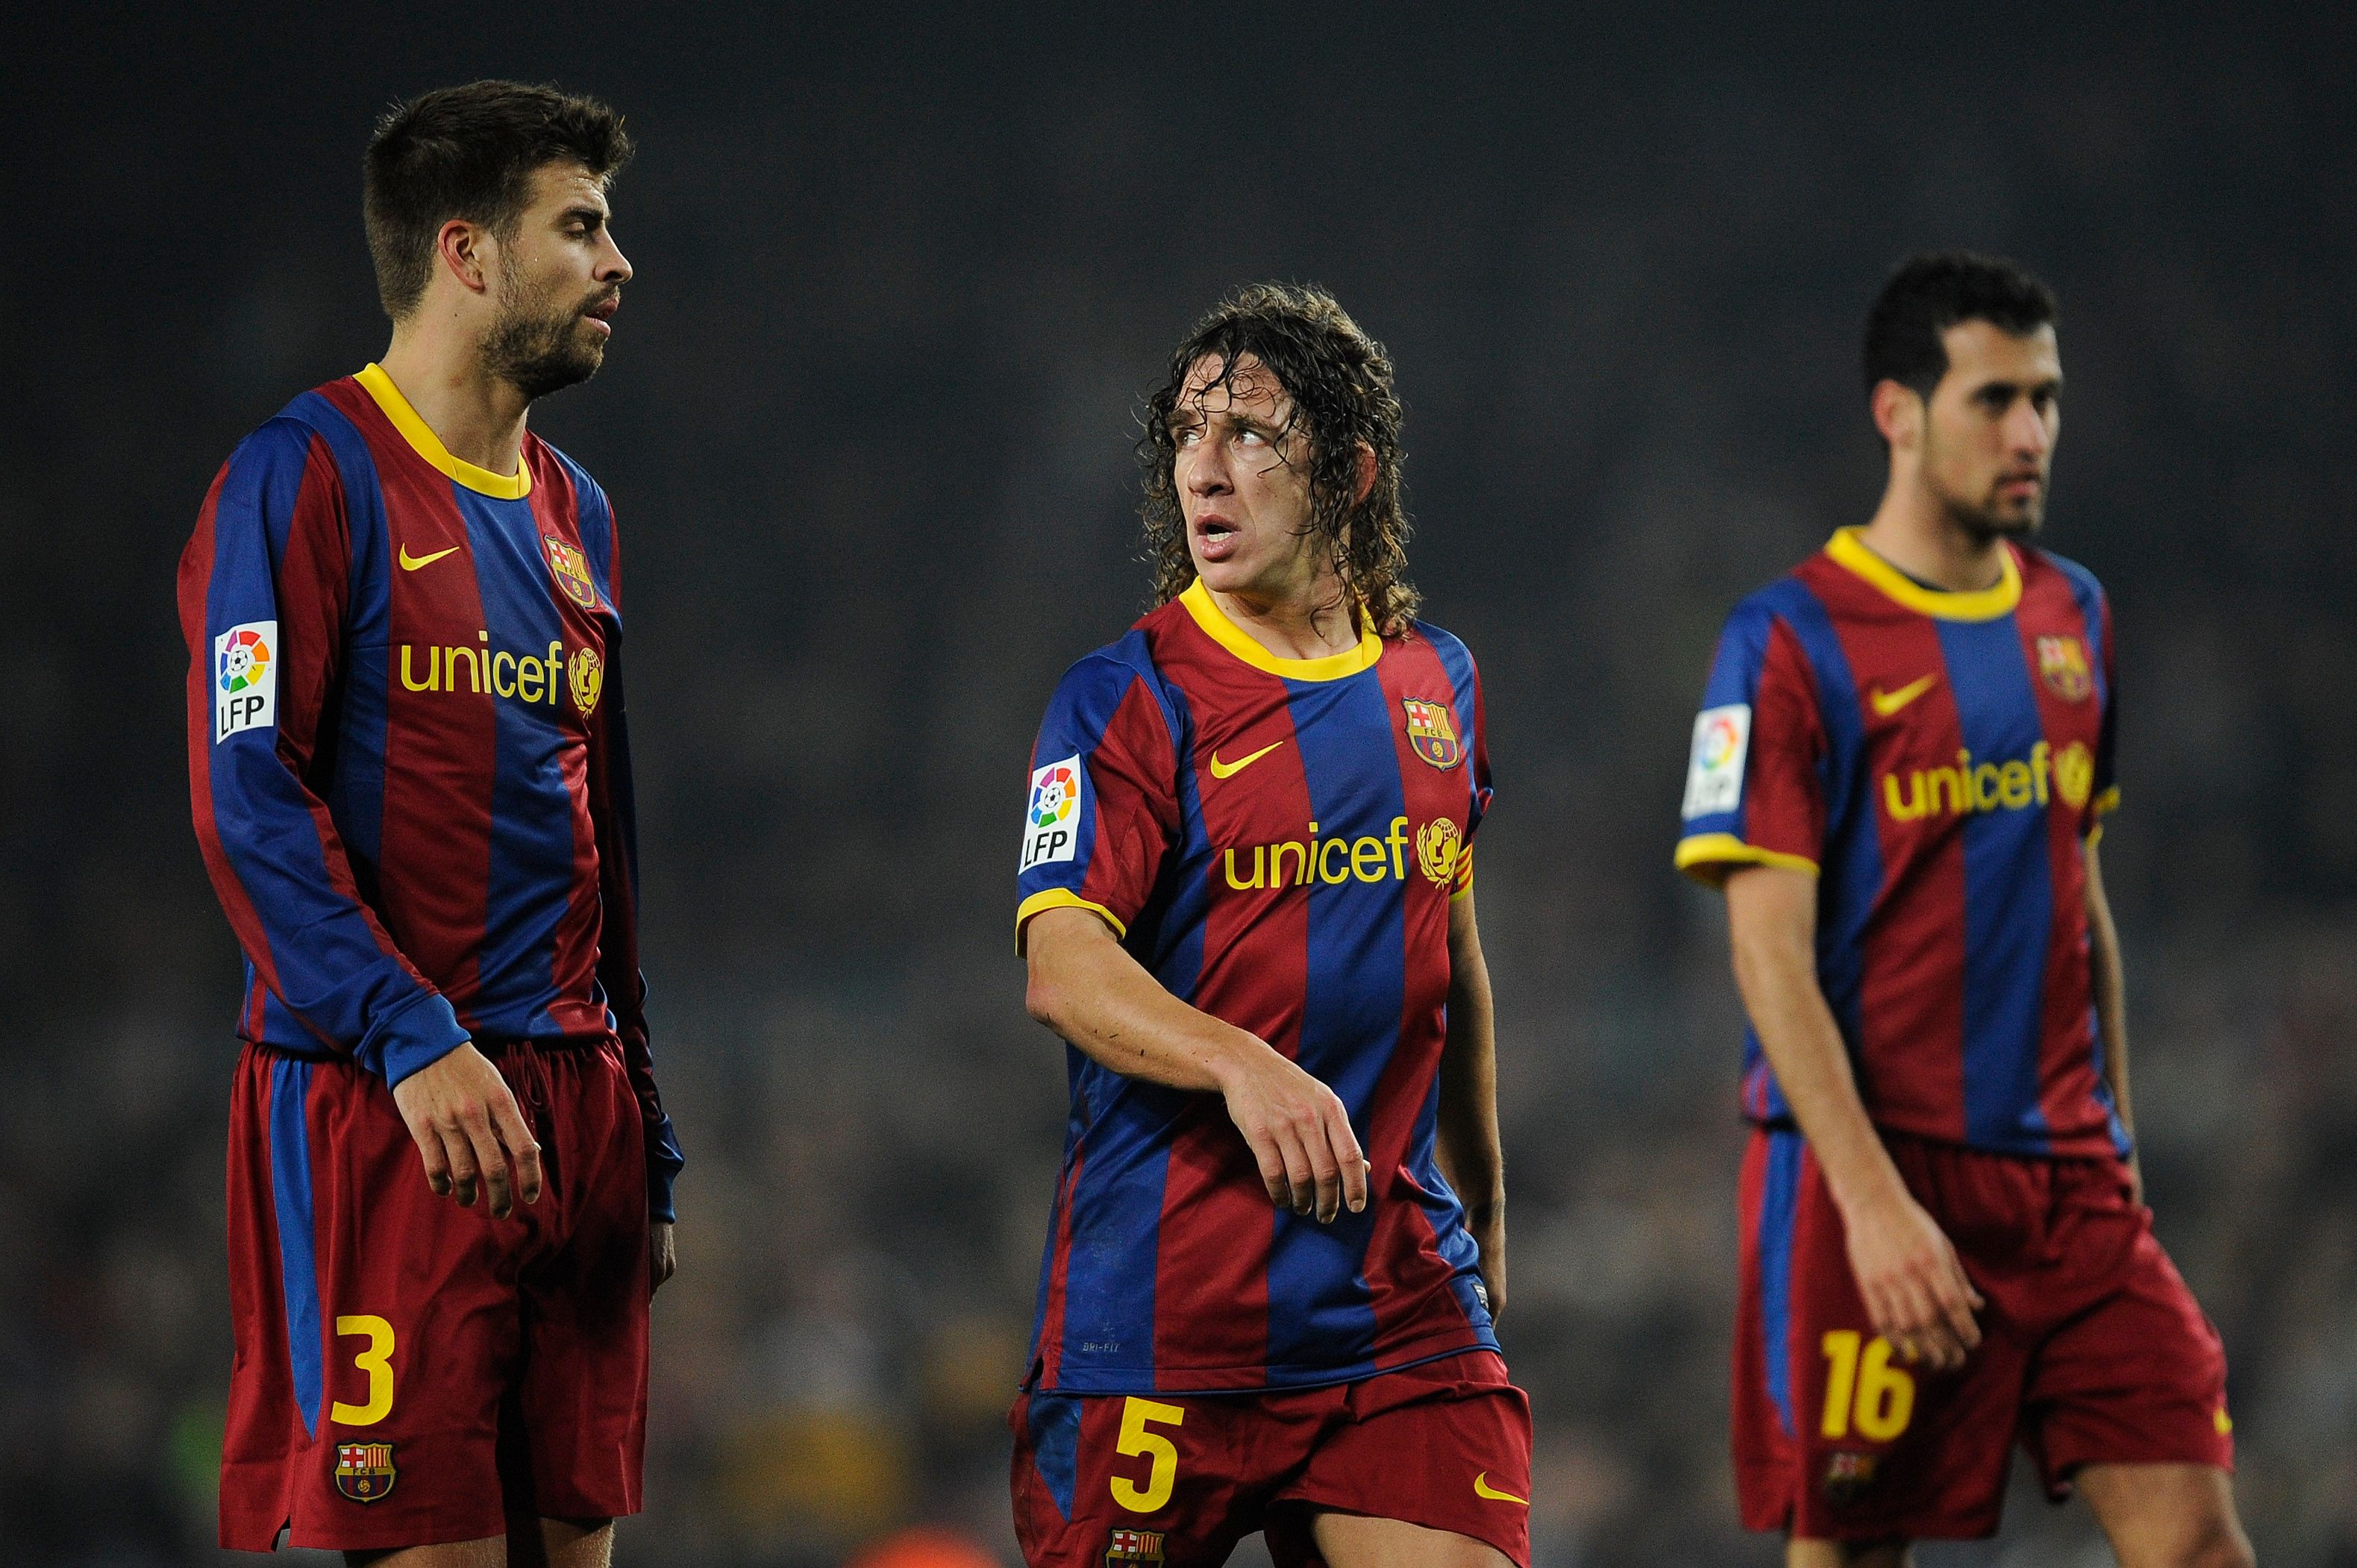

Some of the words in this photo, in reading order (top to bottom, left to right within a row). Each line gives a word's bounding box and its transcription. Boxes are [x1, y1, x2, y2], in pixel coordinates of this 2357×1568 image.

[401, 630, 563, 705] unicef
[221, 695, 265, 736] LFP
[1424, 728, 1443, 737] FCB
[1884, 740, 2050, 821] unicef
[1024, 830, 1068, 868] LFP
[1224, 816, 1409, 890] unicef
[331, 1314, 395, 1426] 3
[1083, 1342, 1120, 1352] DRI-FIT
[1821, 1329, 1916, 1442] 16
[1110, 1396, 1185, 1513] 5
